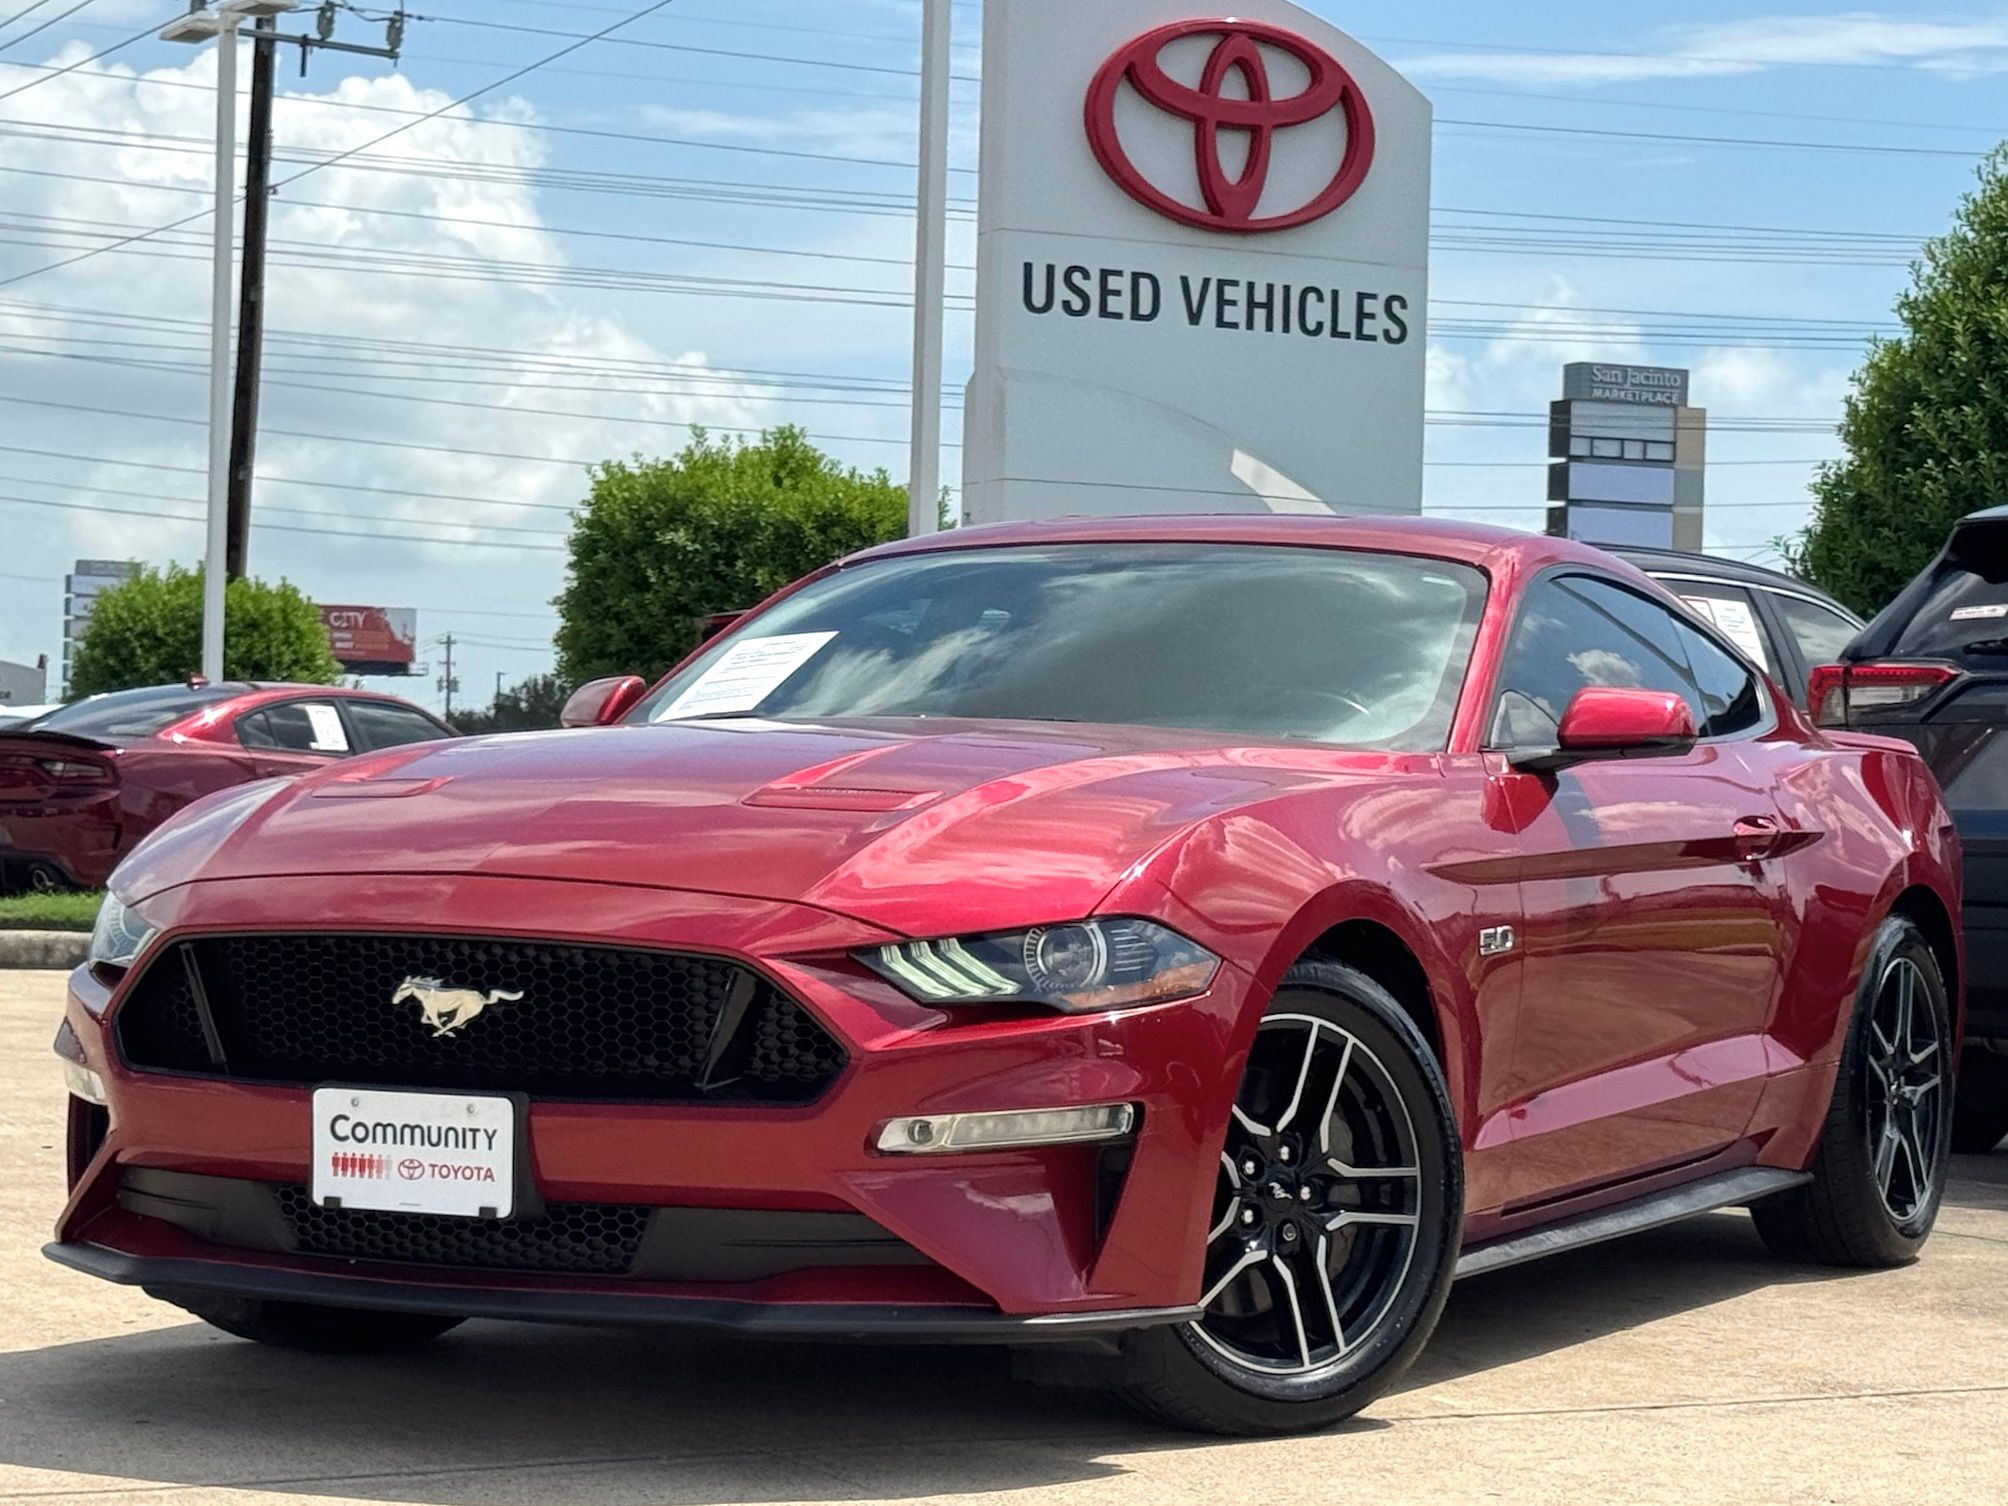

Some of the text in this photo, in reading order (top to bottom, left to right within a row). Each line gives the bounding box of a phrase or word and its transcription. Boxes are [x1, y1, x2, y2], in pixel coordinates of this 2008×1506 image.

[1023, 262, 1408, 345] USED VEHICLES
[1592, 365, 1680, 388] San Jacinto
[1592, 388, 1680, 404] MARKETPLACE
[429, 1163, 495, 1182] TOYOTA
